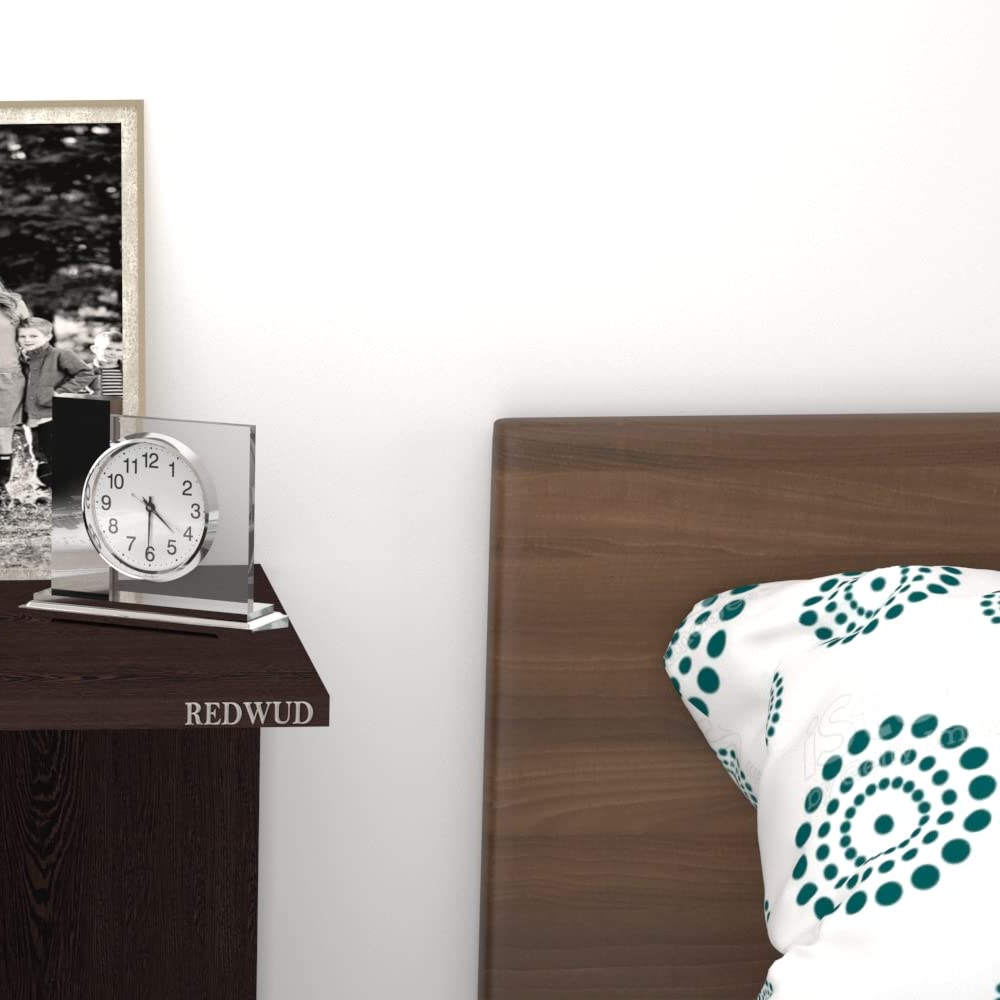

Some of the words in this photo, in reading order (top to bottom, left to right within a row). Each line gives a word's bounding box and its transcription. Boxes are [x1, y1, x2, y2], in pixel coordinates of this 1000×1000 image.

[123, 458, 138, 474] 11
[142, 452, 159, 469] 12
[168, 462, 176, 477] 1
[107, 473, 124, 490] 10
[182, 480, 193, 496] 2
[101, 495, 112, 511] 9
[190, 503, 201, 519] 3
[108, 518, 119, 534] 8
[183, 526, 193, 541] 4
[126, 536, 136, 551] 7
[166, 540, 177, 555] 5
[144, 546, 155, 562] 6
[184, 700, 314, 726] REDWUD
